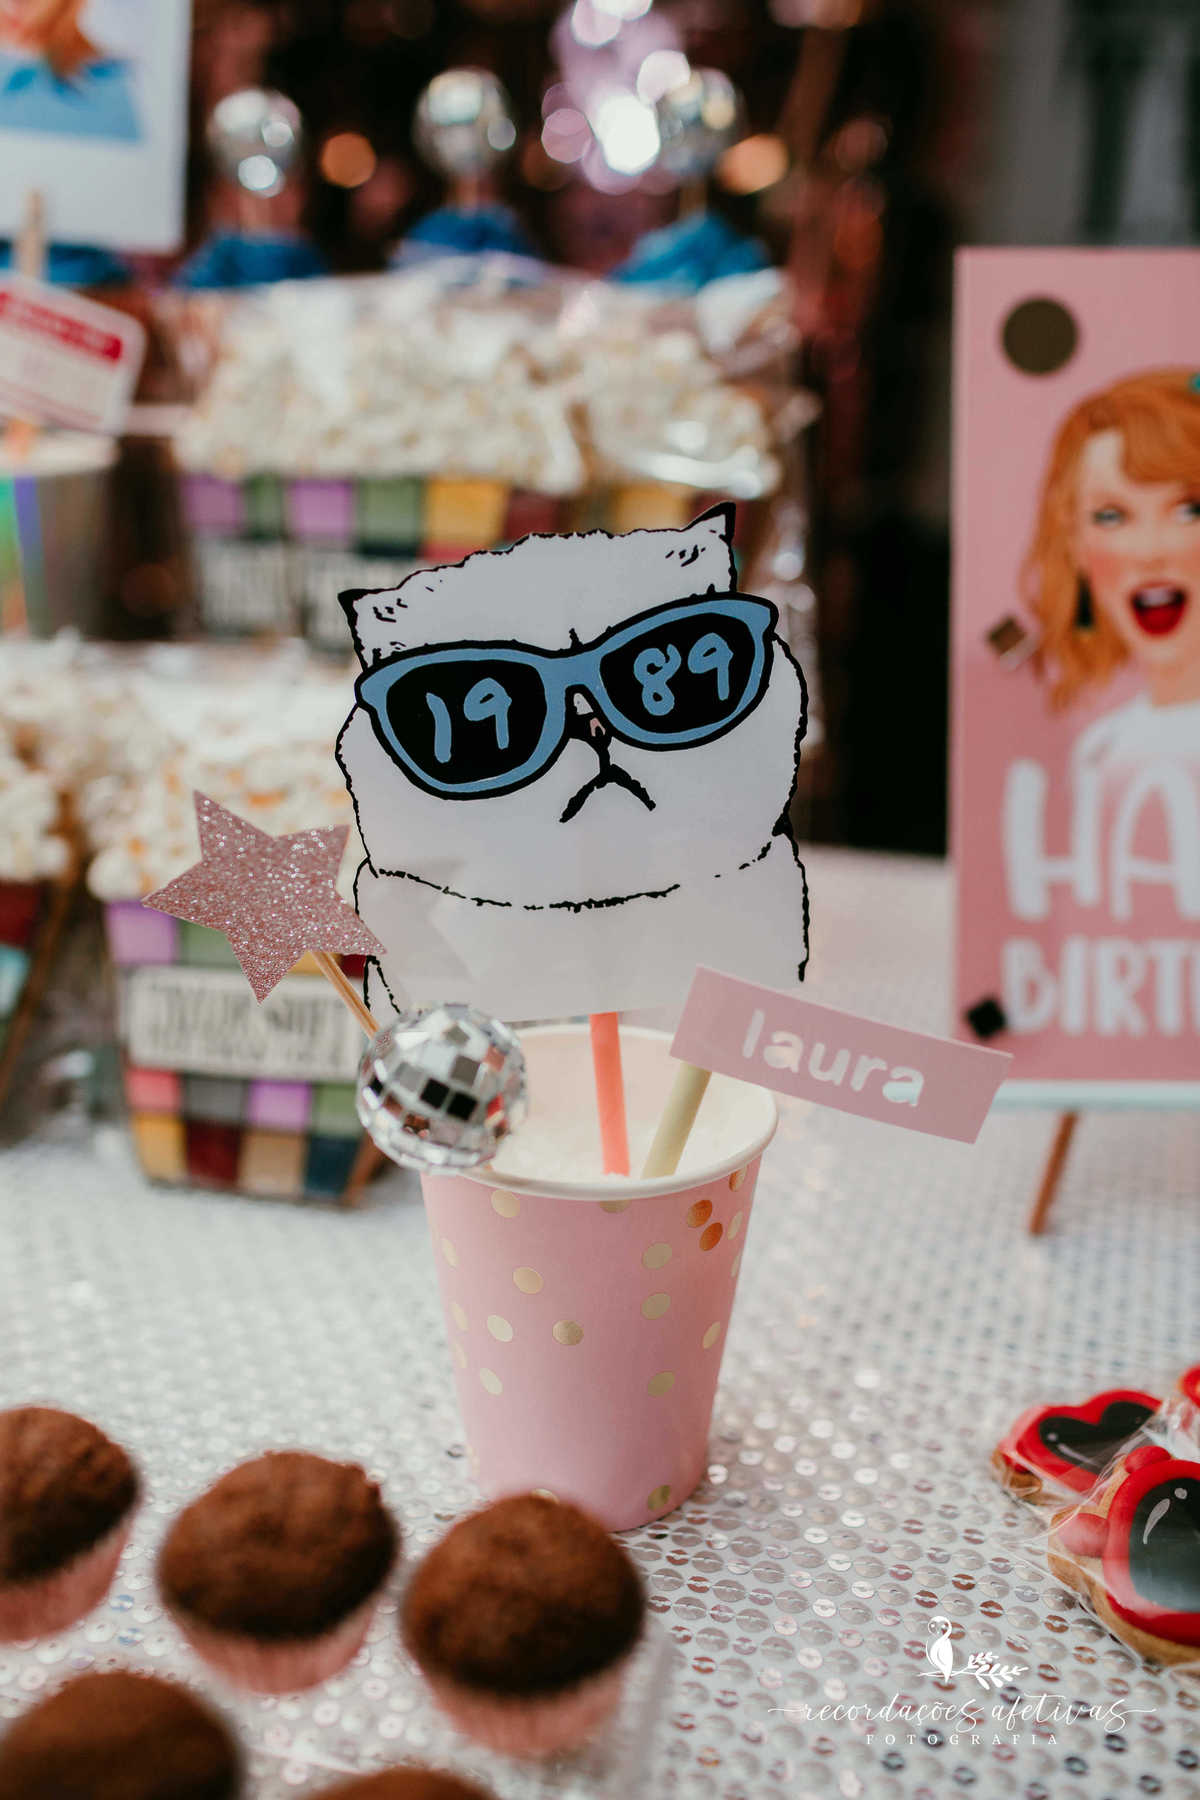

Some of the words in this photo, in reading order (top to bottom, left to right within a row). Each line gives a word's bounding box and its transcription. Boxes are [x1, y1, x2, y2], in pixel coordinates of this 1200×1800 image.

[426, 677, 512, 763] 19
[634, 632, 734, 716] 89
[1003, 934, 1200, 1037] BIRT
[742, 1009, 924, 1106] laura
